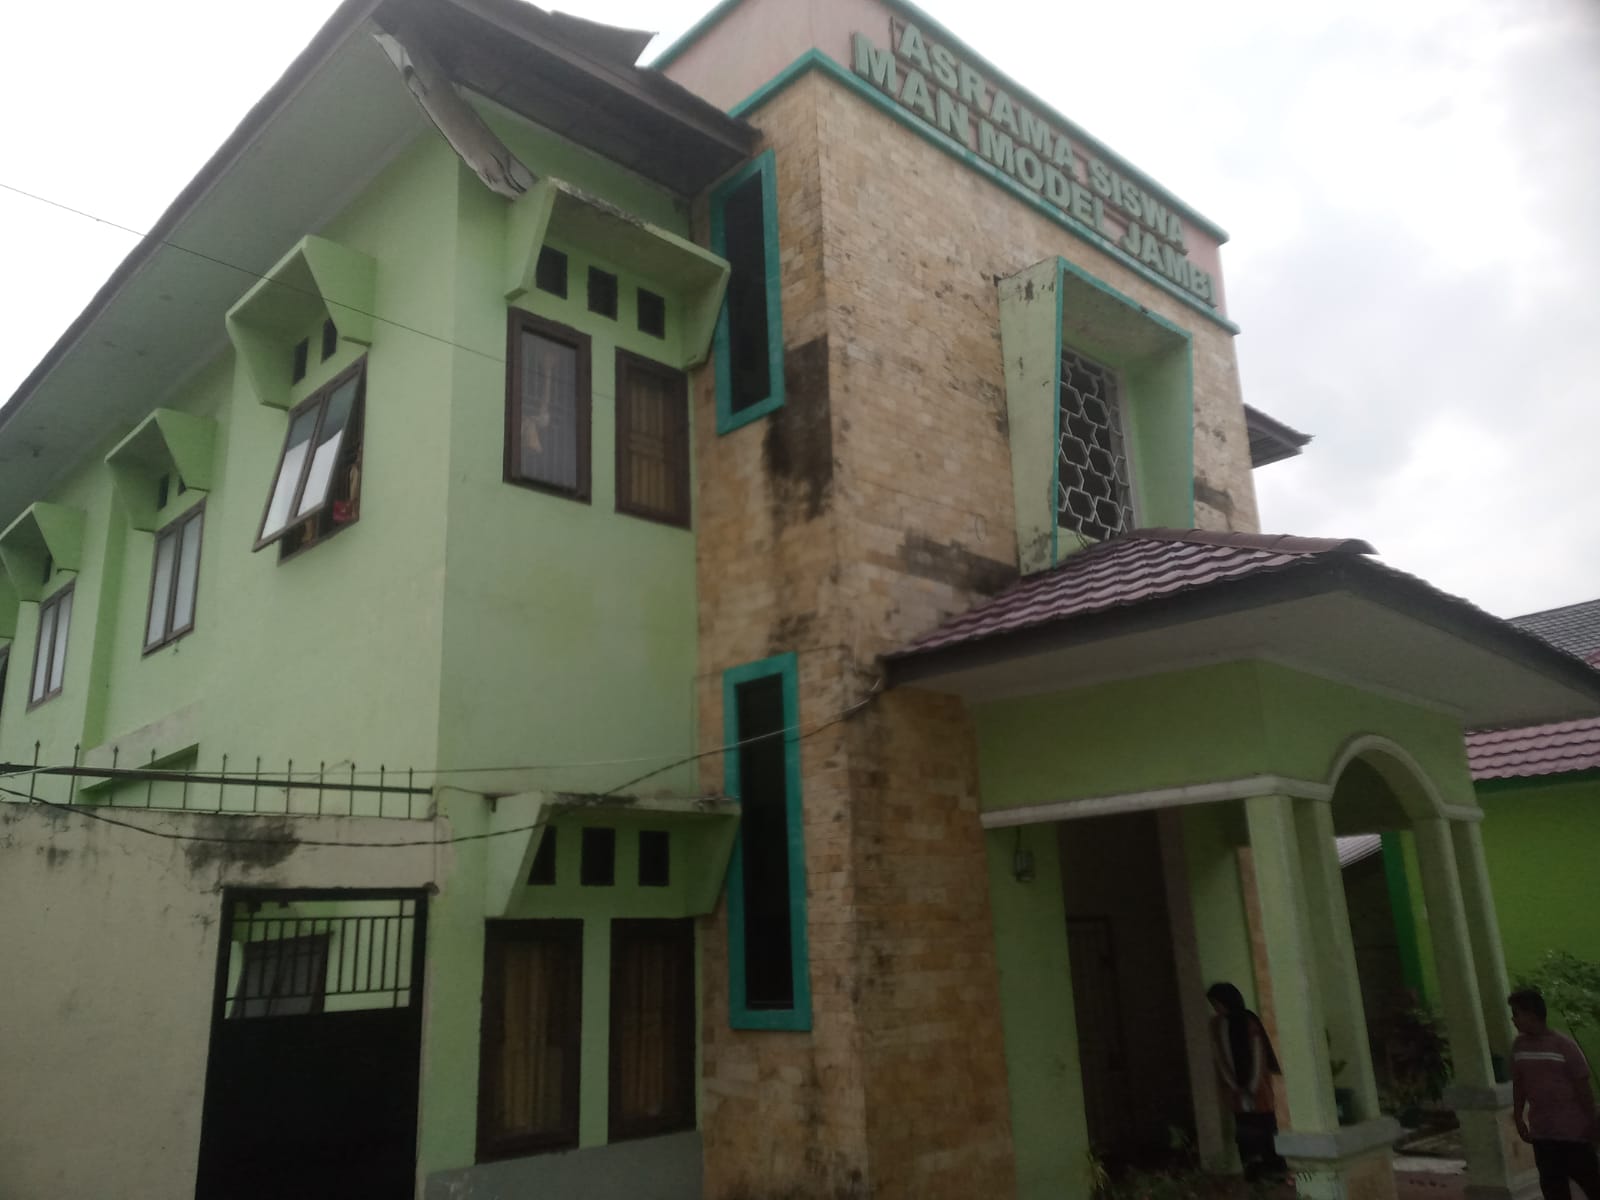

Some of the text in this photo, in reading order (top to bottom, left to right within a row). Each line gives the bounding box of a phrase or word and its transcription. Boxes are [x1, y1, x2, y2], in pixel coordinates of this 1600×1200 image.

[853, 32, 1216, 307] MAN MODEL JAMBI
[898, 22, 1186, 248] ASRAMA SISWA
